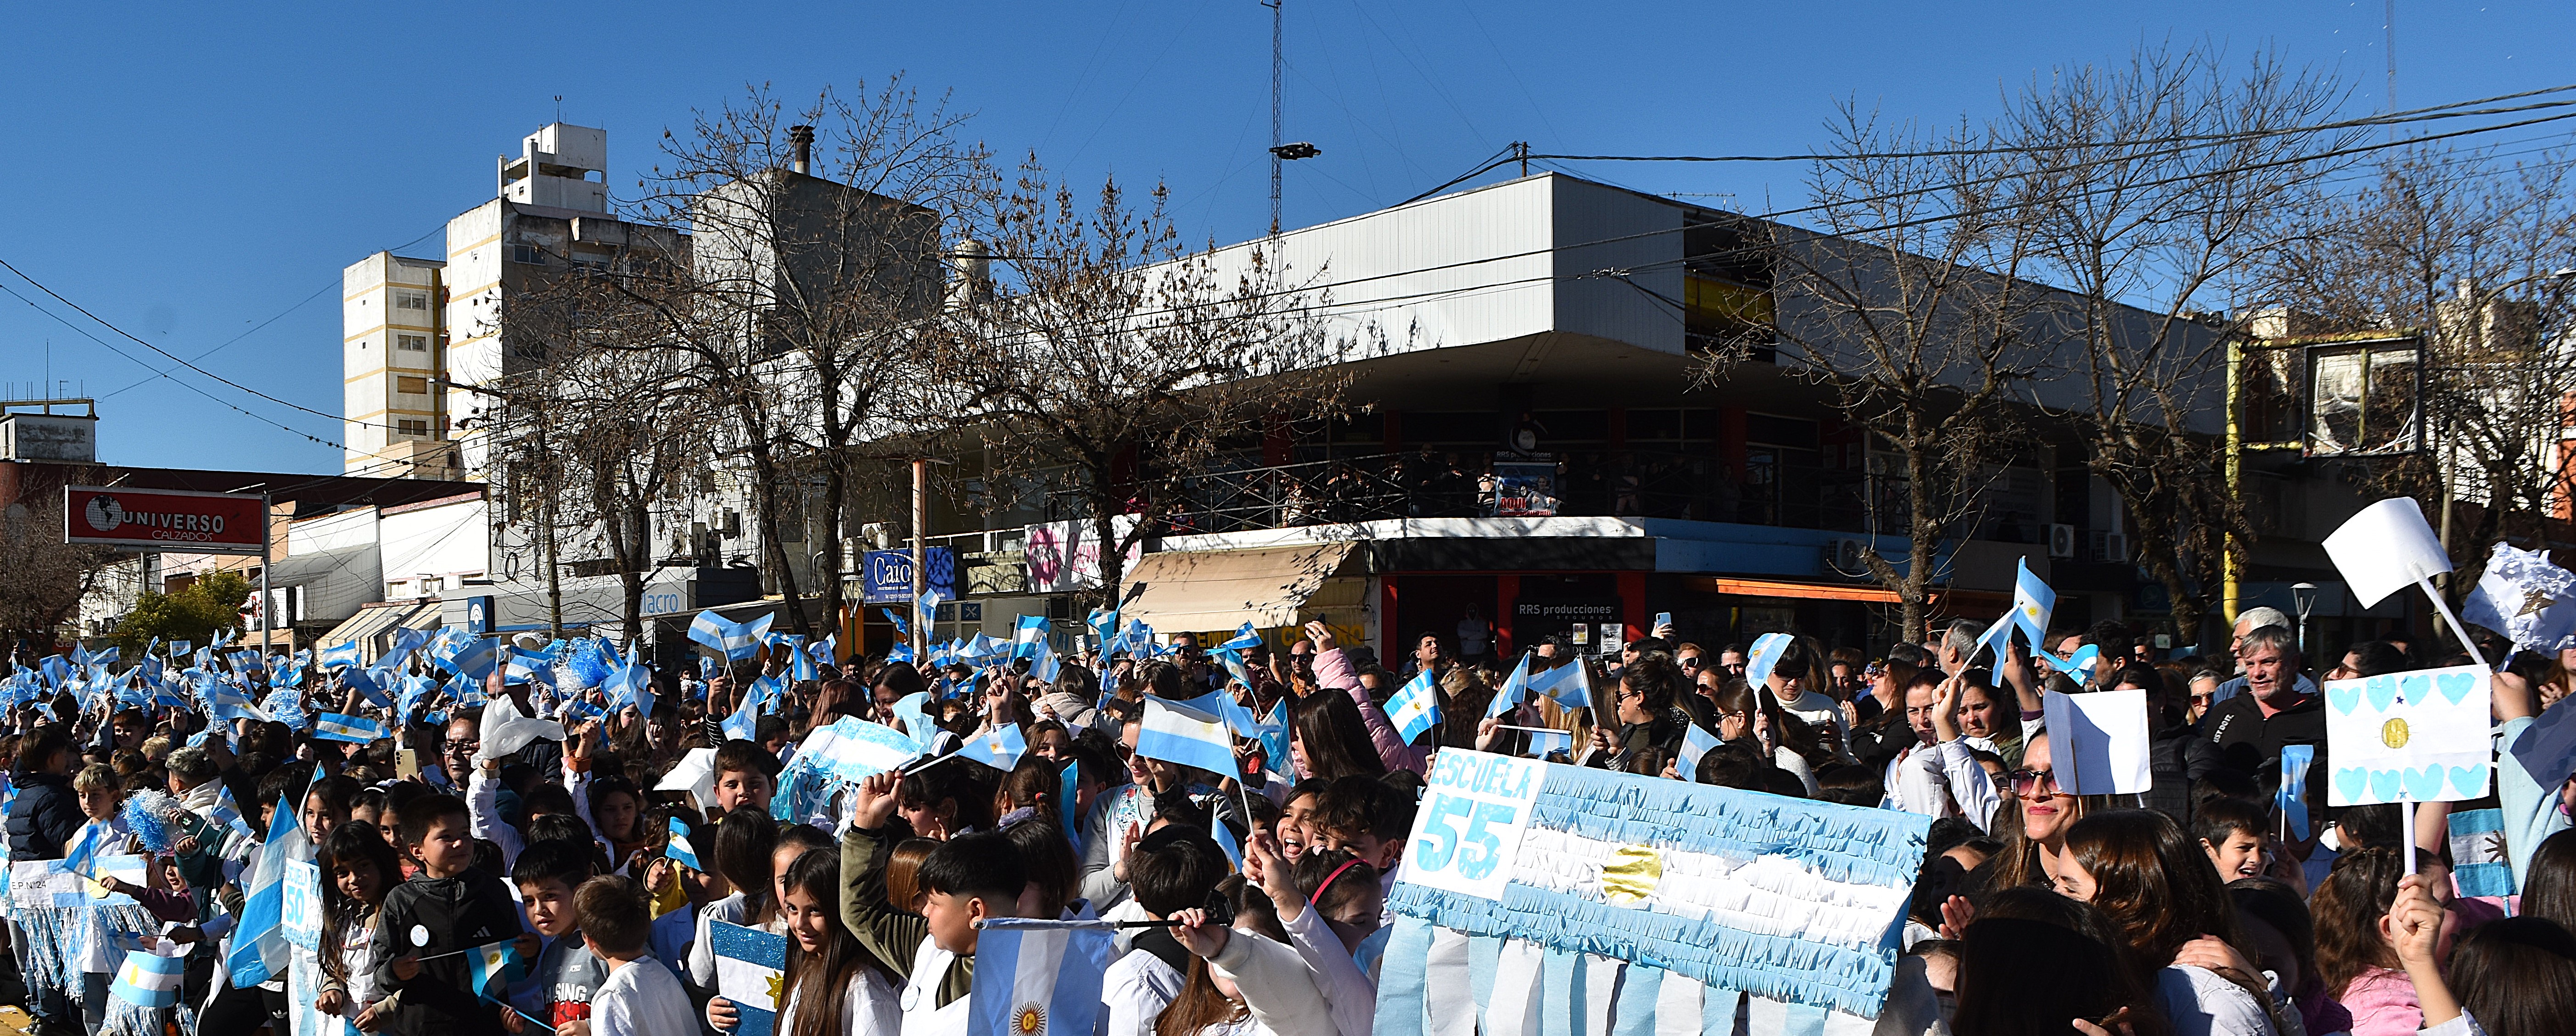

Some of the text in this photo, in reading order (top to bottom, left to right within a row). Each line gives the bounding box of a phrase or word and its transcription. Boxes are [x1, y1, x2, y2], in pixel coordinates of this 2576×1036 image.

[1500, 497, 1526, 510] AQUI
[122, 512, 224, 533] UNIVERSO
[152, 530, 213, 541] CALZADOS
[874, 557, 911, 585] Caio
[1519, 604, 1612, 616] RRS producciones
[1281, 624, 1365, 646] CERO
[2212, 730, 2223, 743] UST
[2218, 720, 2229, 730] DO
[1430, 751, 1533, 799] ESCUELA
[1417, 792, 1518, 880] 55
[286, 885, 305, 926] 50
